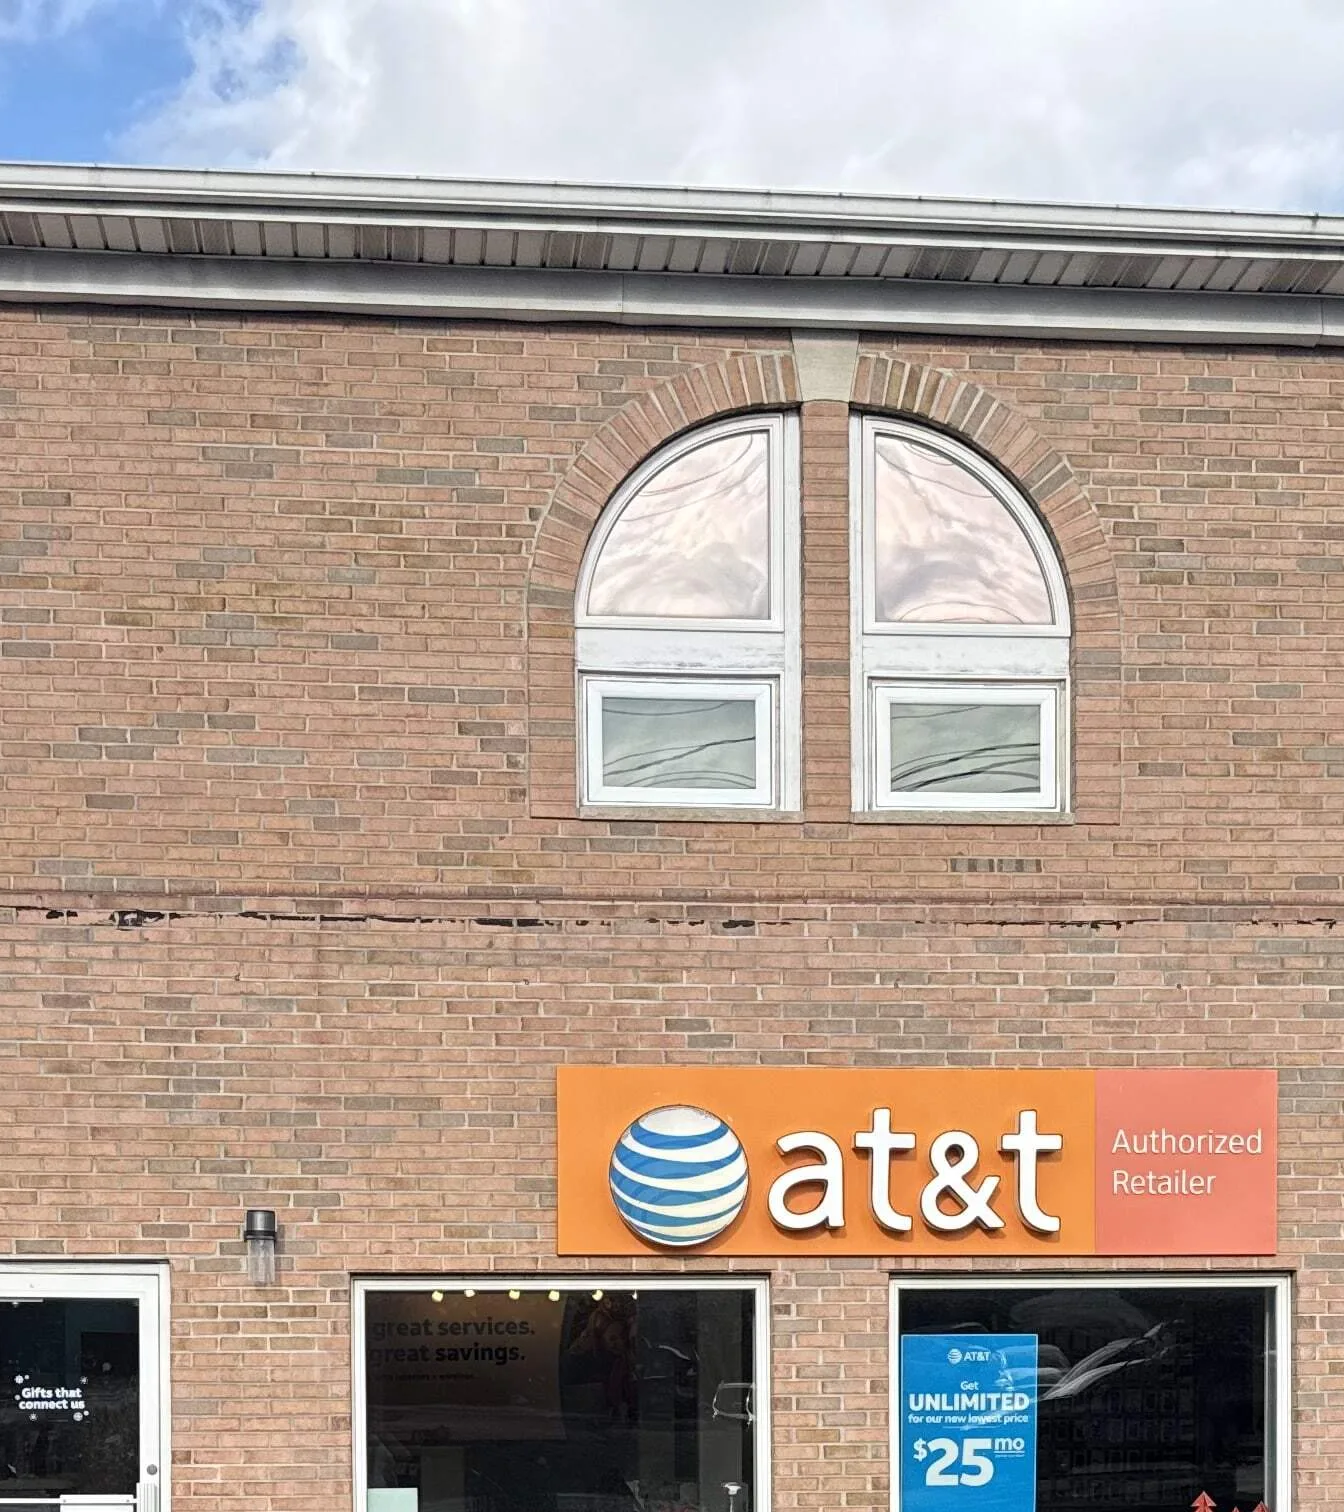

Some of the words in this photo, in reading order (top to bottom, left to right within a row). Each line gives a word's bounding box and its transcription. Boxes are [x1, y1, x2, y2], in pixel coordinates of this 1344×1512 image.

[1111, 1128, 1263, 1155] Authorized
[766, 1107, 1063, 1233] at&t
[1112, 1170, 1217, 1195] Retailer
[438, 1316, 536, 1336] services.
[435, 1342, 526, 1366] savings.
[963, 1351, 991, 1362] AT&T
[21, 1386, 54, 1398] Gifts
[54, 1386, 82, 1398] that
[960, 1380, 980, 1391] Get
[18, 1399, 69, 1410] connect
[70, 1400, 85, 1410] us
[908, 1392, 1030, 1411] UNLIMITED
[908, 1413, 924, 1423] for
[925, 1414, 943, 1423] our
[944, 1414, 967, 1423] new
[968, 1413, 1003, 1424] lowest
[1003, 1413, 1029, 1425] price
